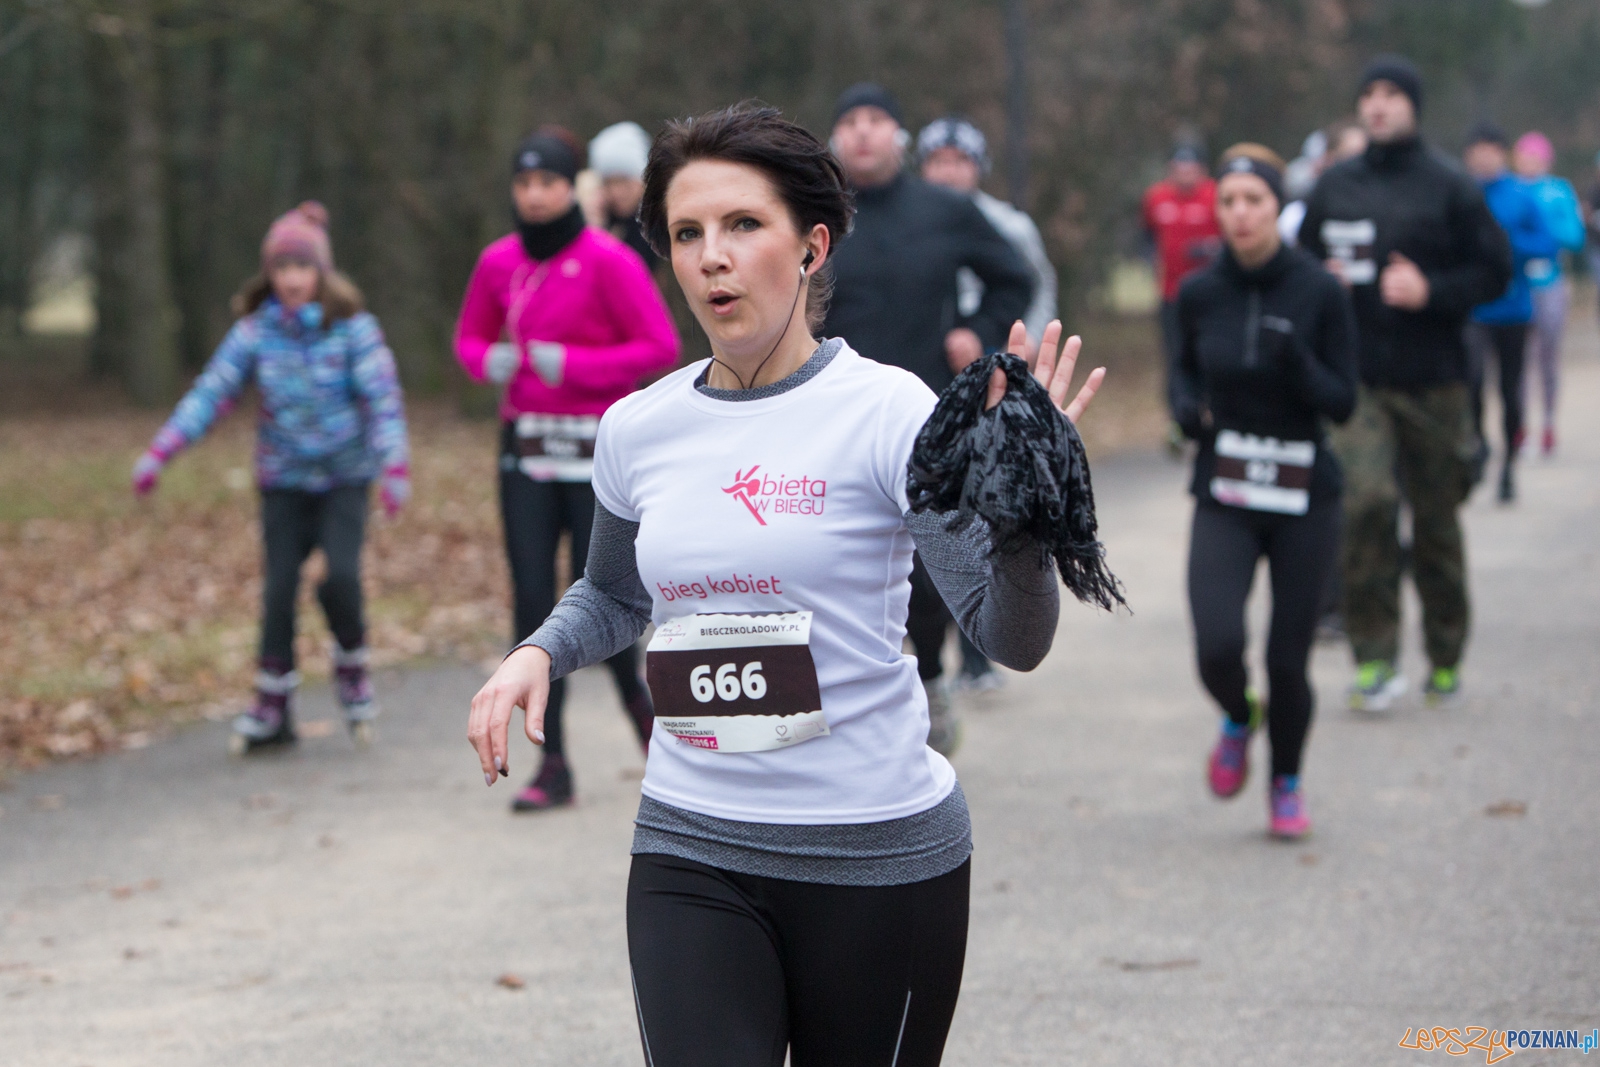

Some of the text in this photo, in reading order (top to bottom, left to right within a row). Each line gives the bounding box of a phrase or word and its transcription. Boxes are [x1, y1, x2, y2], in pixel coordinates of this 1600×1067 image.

[774, 498, 825, 516] BIEGU
[656, 573, 783, 602] bieg kobiet
[700, 624, 800, 637] BIEGCZEKOLADOWY.PL
[689, 661, 767, 703] 666
